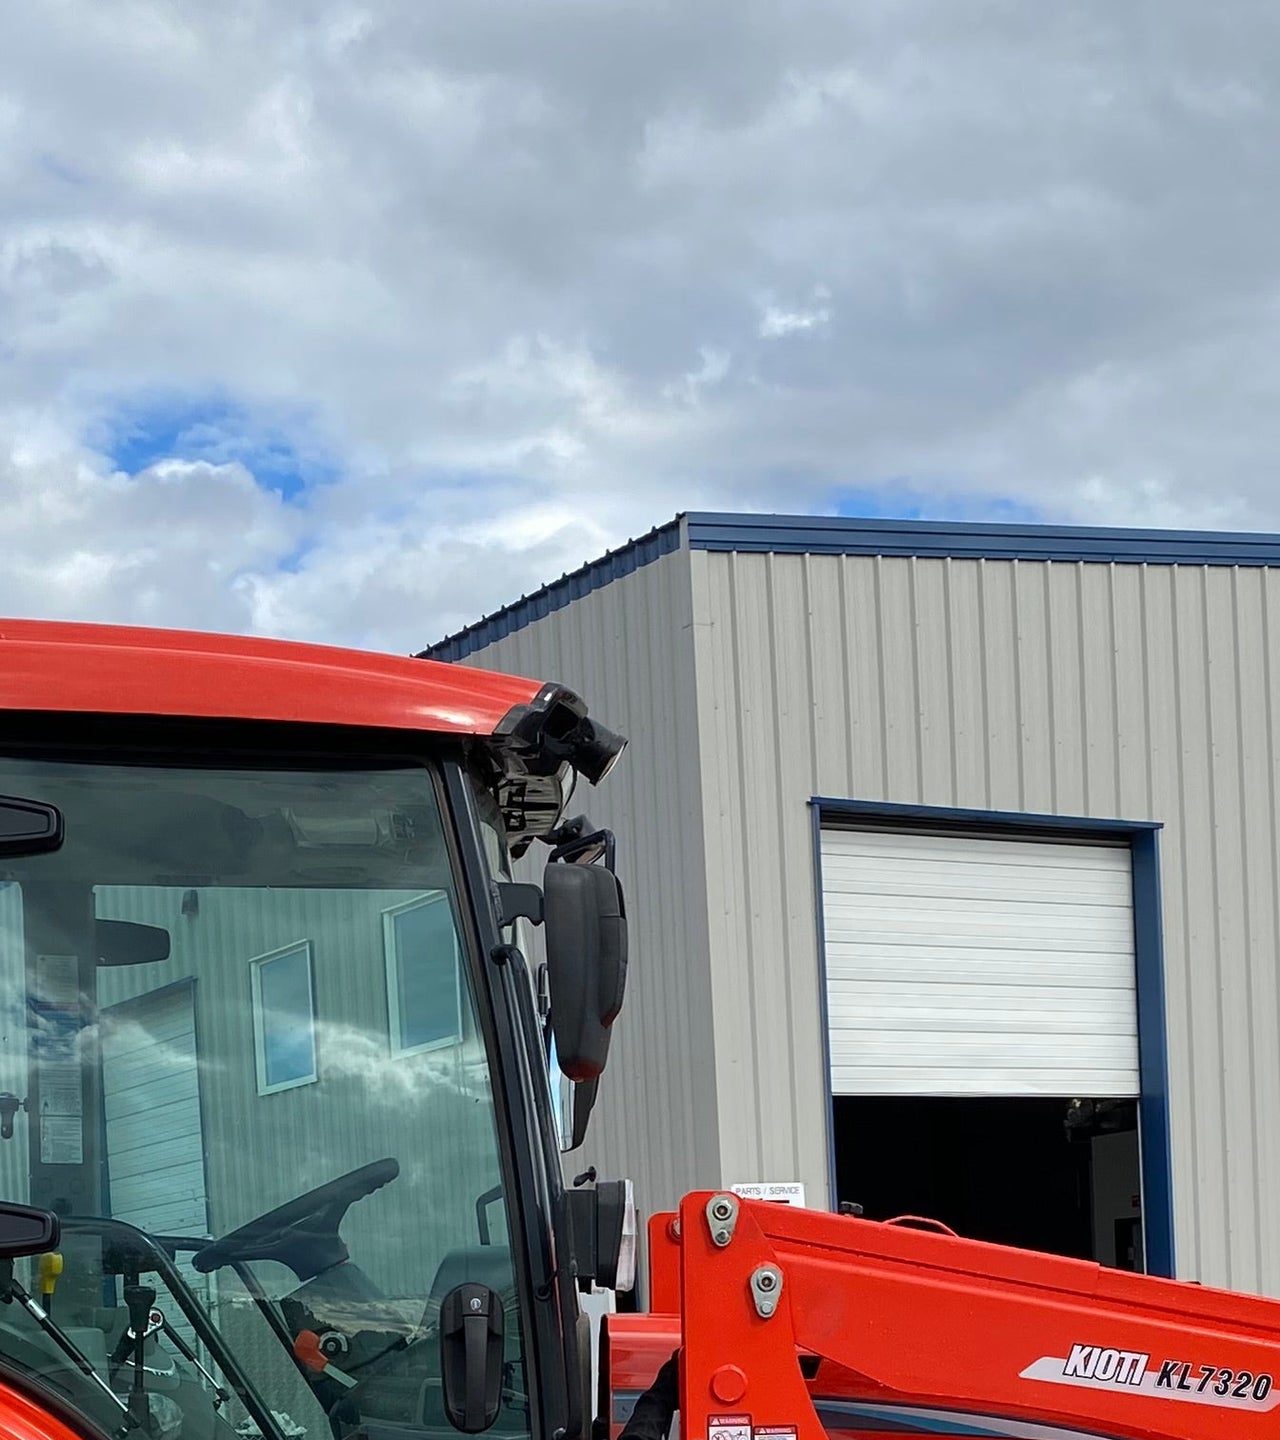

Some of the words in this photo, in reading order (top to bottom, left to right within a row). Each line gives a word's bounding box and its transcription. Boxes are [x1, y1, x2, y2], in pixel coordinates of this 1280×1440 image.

[735, 1187, 761, 1195] PARTS
[769, 1186, 801, 1195] SERVICE
[1062, 1343, 1151, 1386] KIOTI
[1155, 1359, 1273, 1402] KL7320
